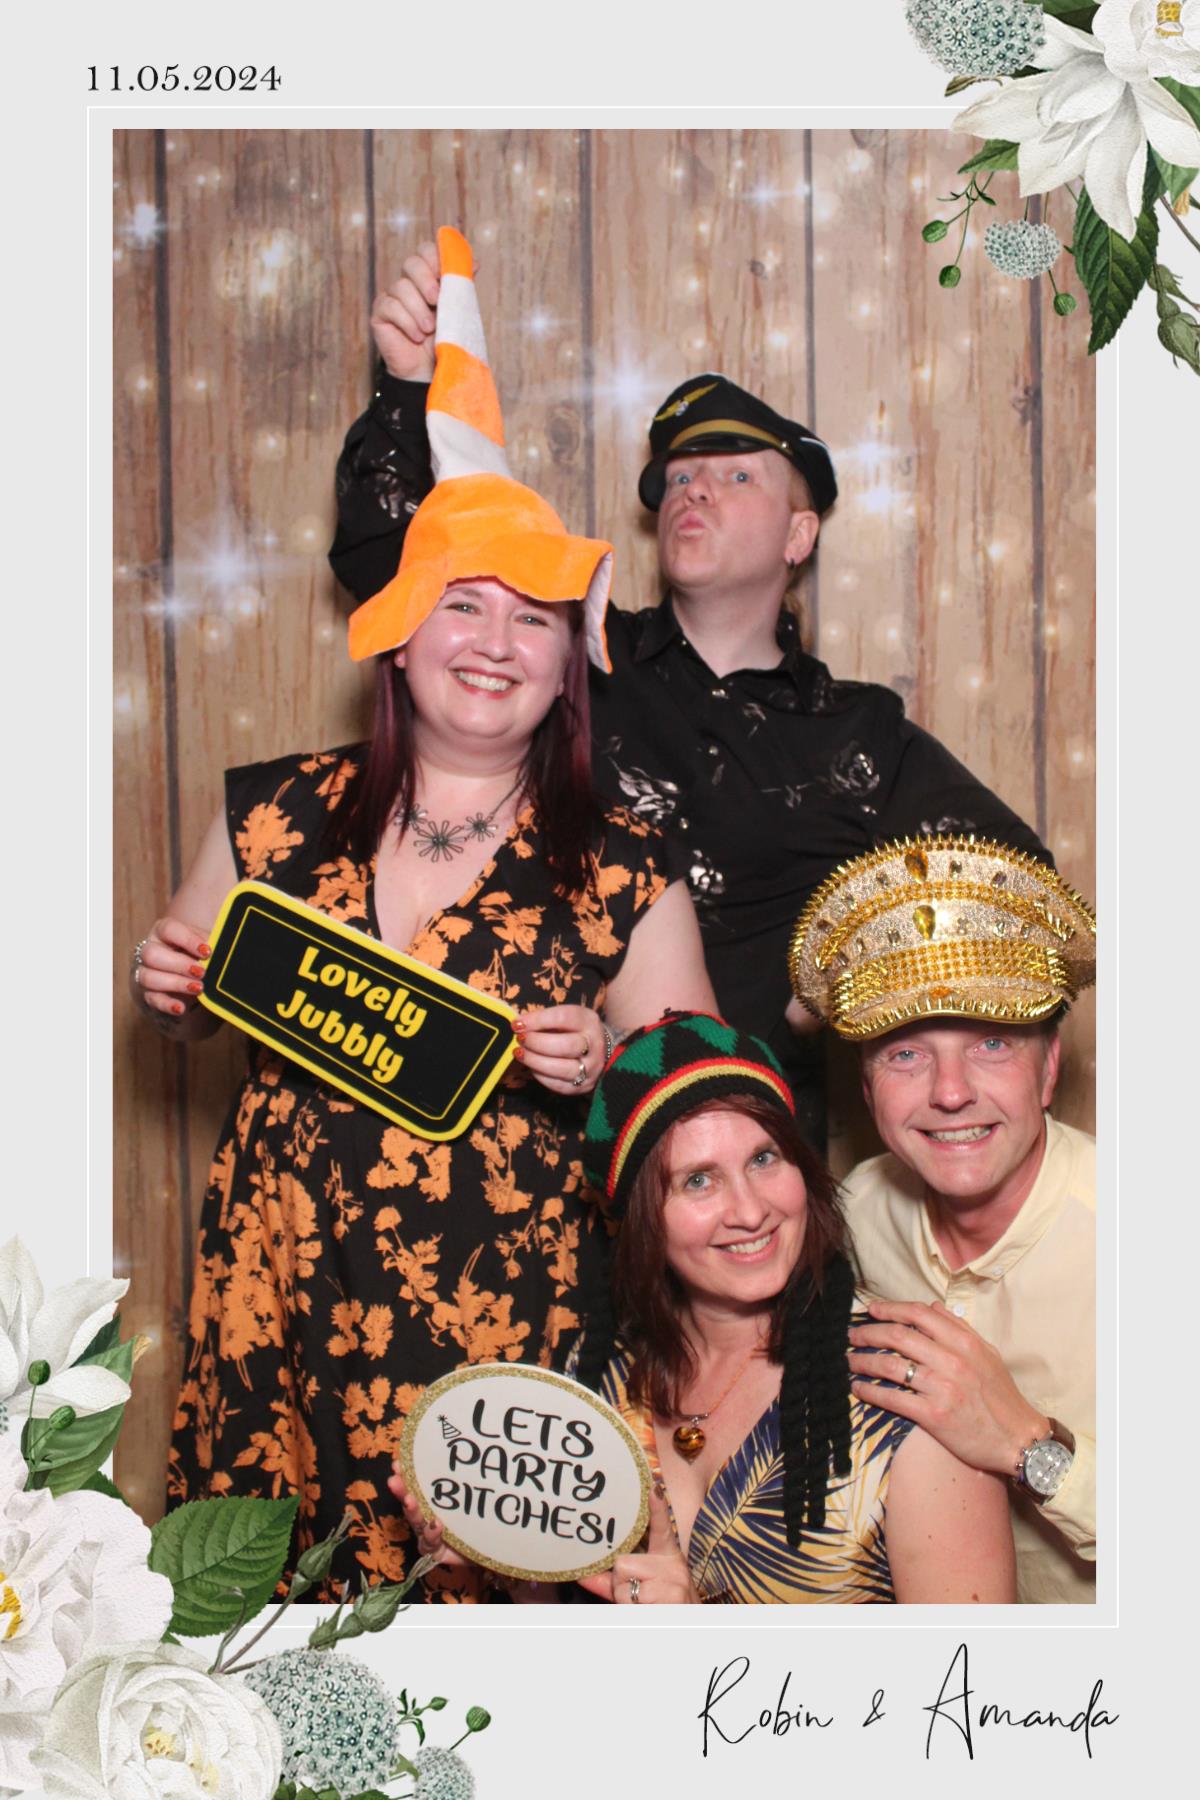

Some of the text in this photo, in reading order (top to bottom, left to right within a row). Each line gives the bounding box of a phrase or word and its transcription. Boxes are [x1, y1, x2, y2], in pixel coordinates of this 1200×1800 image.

[297, 946, 428, 1038] Lovely
[276, 989, 404, 1084] Jubbly
[471, 1398, 594, 1458] LETS
[446, 1437, 606, 1502] PARTY
[430, 1477, 616, 1549] BITCHES!
